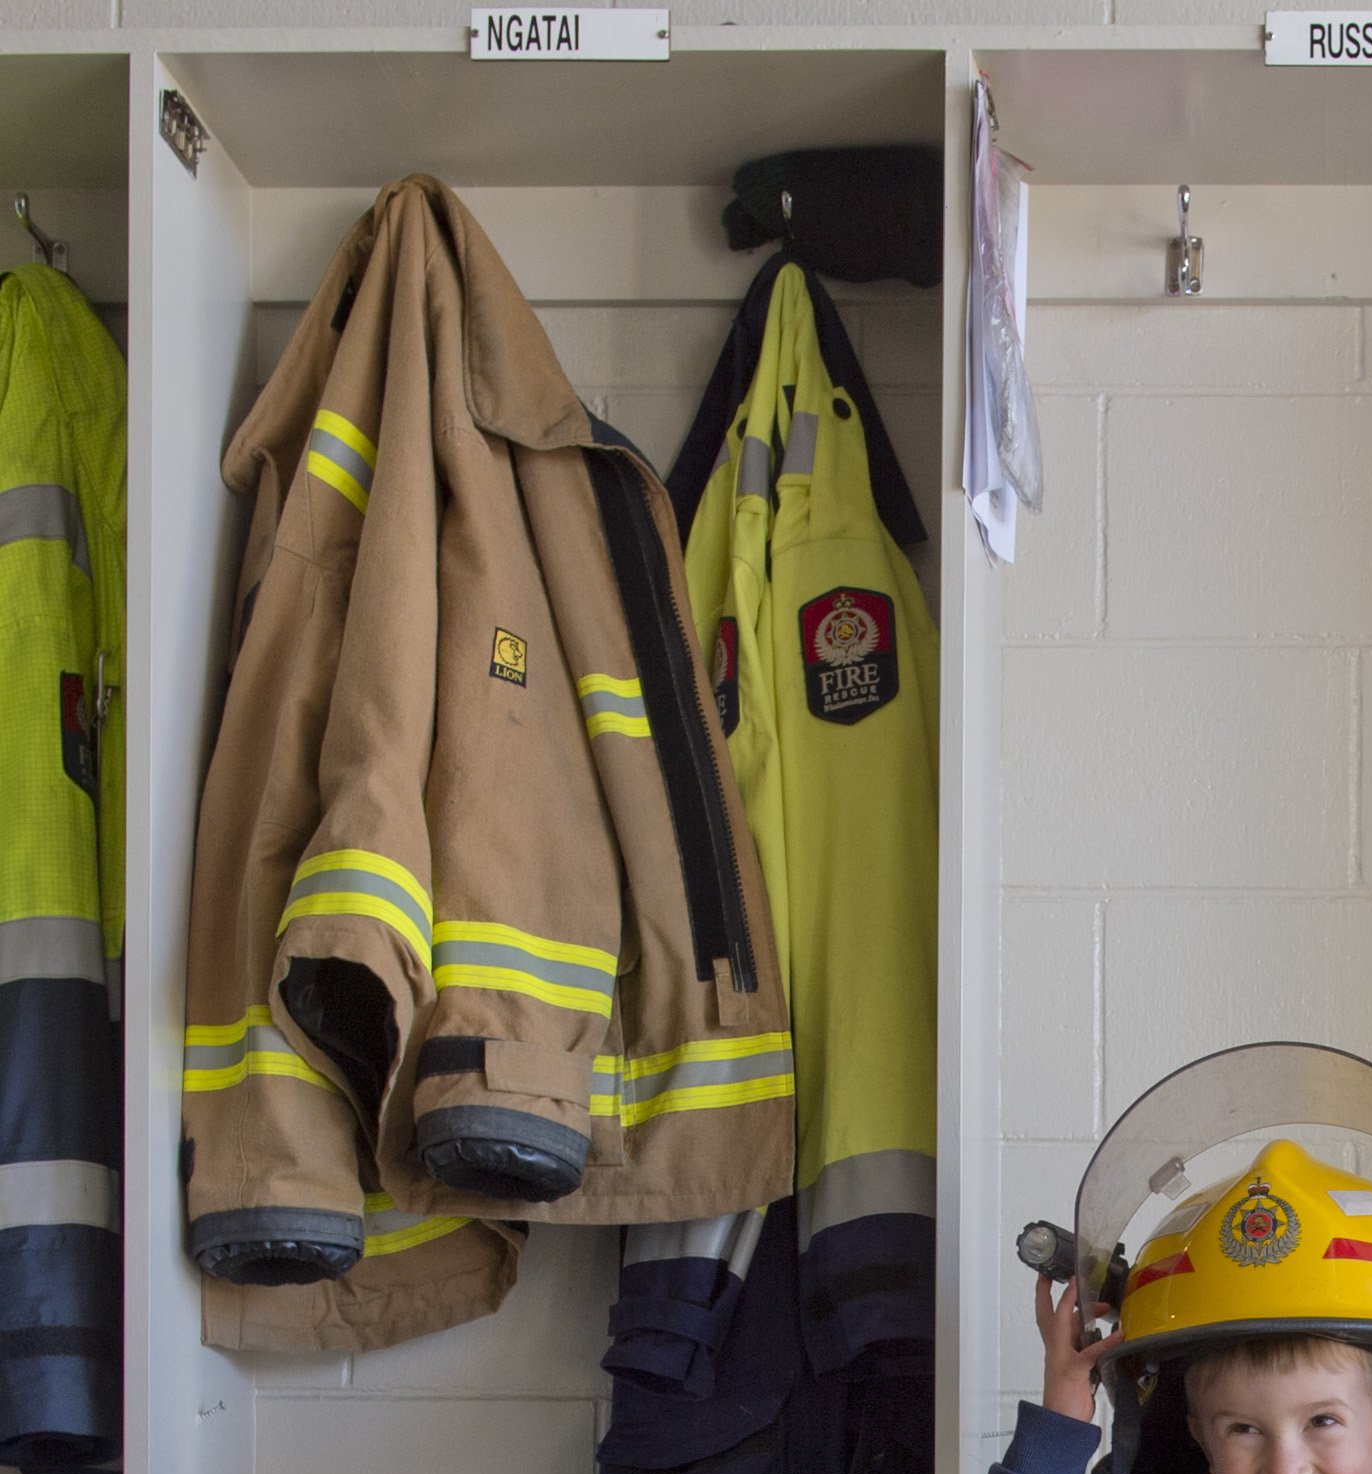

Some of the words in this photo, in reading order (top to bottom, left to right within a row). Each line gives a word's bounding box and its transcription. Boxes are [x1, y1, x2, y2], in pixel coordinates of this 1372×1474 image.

[488, 15, 579, 51] NGATAI
[495, 665, 523, 683] LION
[819, 664, 880, 695] FIRE
[825, 685, 877, 704] RESCUE
